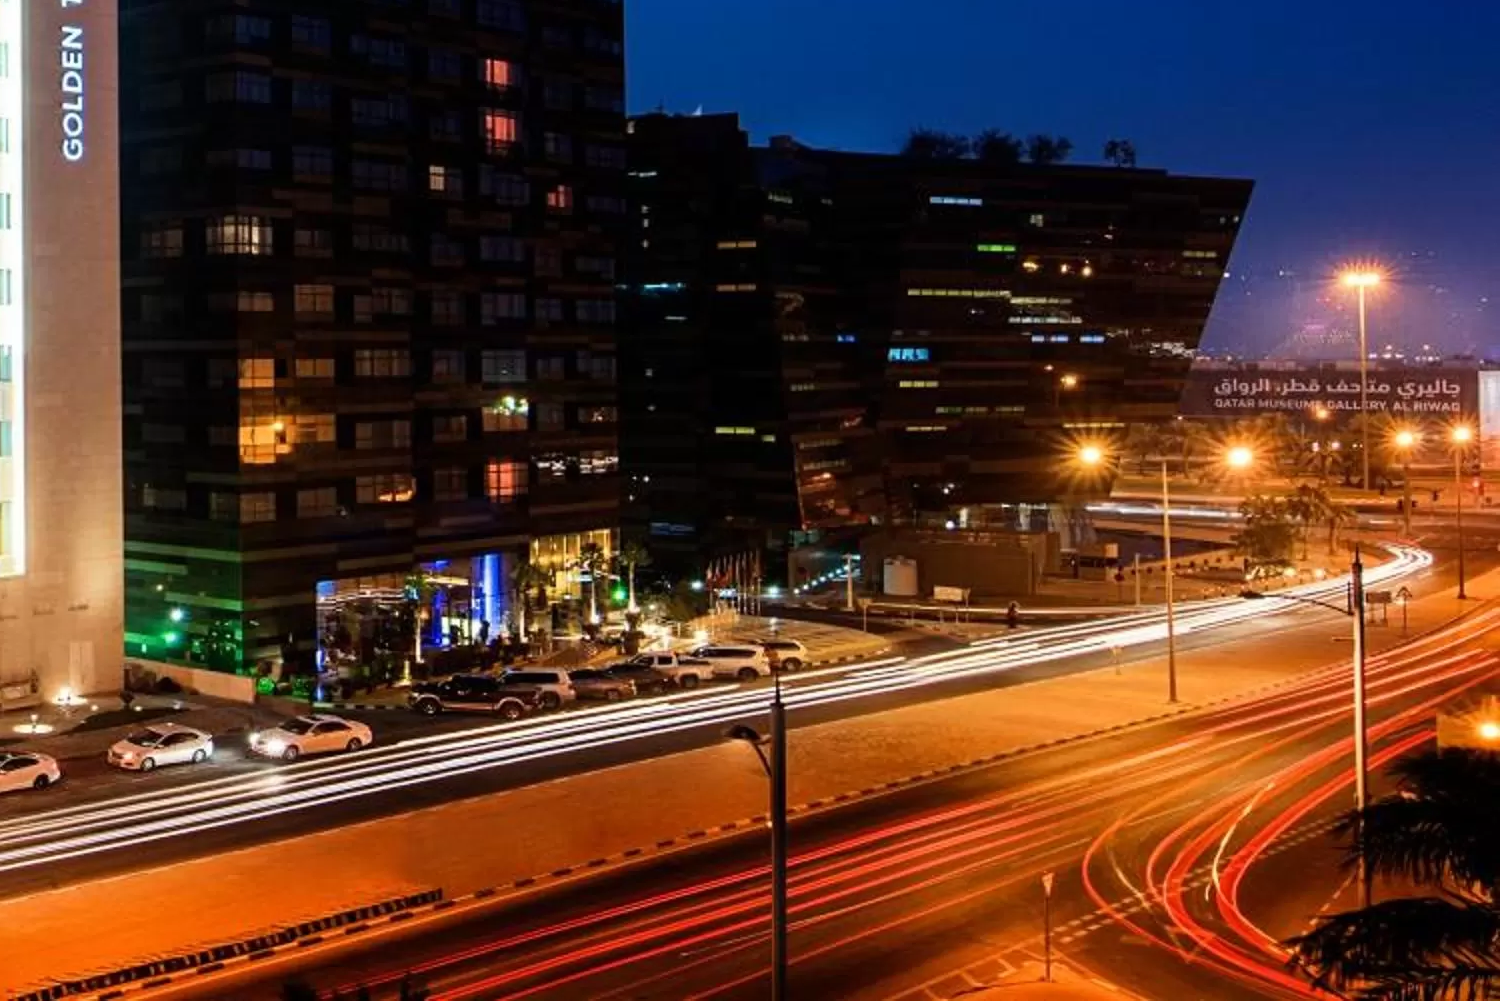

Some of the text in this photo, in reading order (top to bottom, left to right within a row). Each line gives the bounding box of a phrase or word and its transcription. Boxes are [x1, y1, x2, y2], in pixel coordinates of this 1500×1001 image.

[61, 25, 84, 162] GOLDEN
[1325, 378, 1391, 394] متحف
[1215, 398, 1255, 408] QATAR
[1393, 401, 1412, 412] AL
